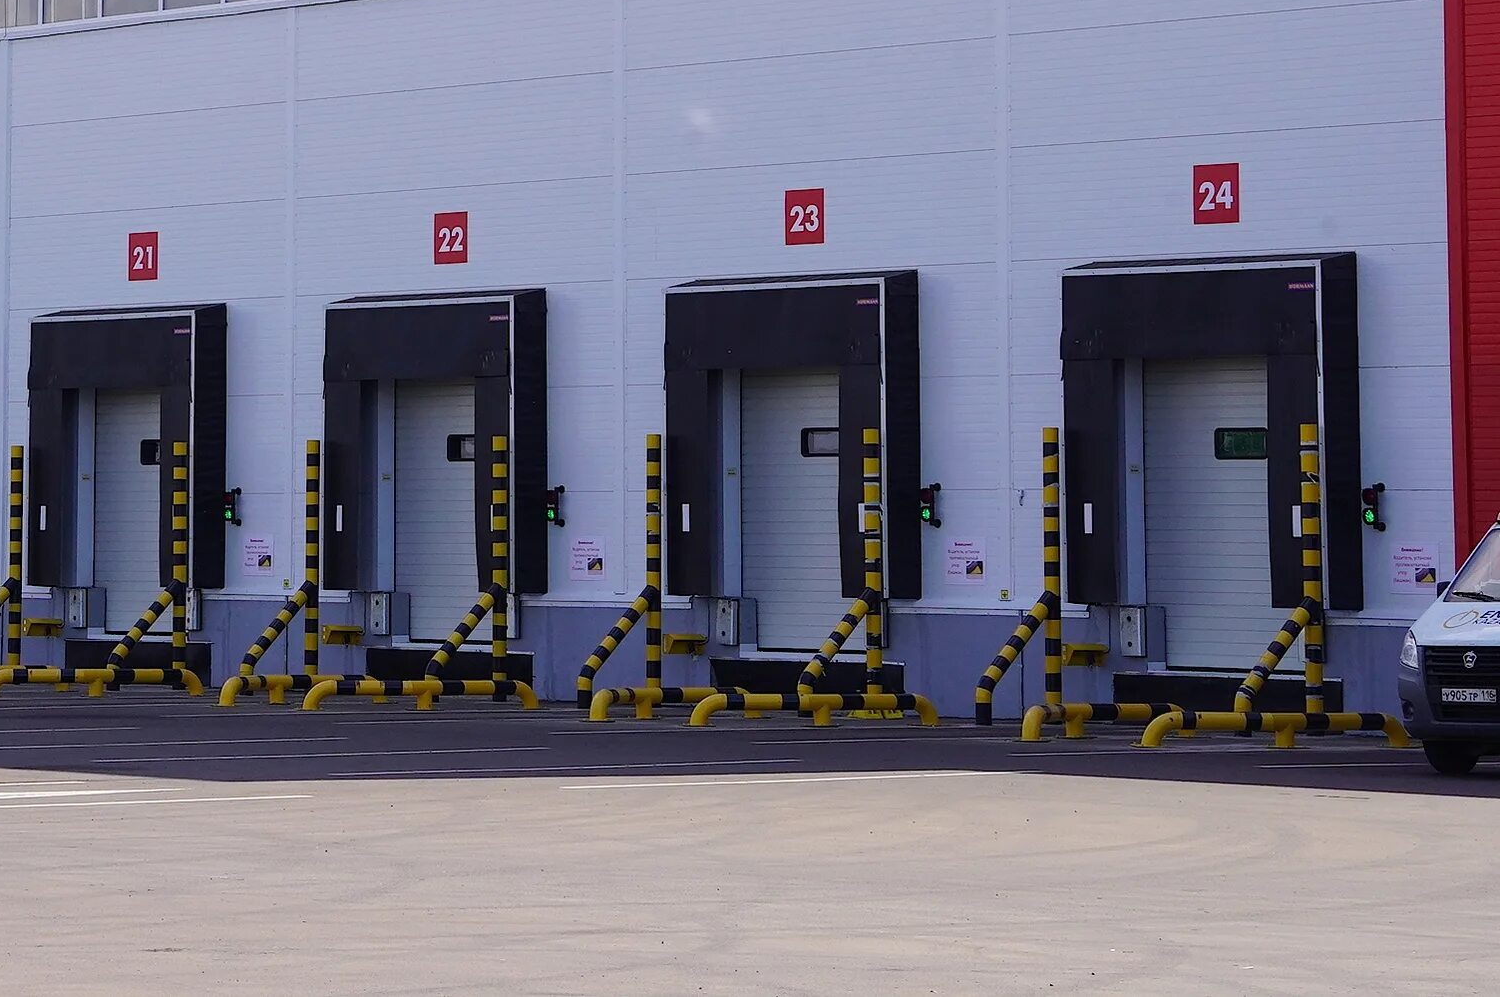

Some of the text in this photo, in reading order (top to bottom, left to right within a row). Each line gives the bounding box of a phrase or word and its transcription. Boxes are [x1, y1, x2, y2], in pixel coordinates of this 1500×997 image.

[1197, 181, 1232, 211] 24
[790, 205, 819, 232] 23
[436, 227, 461, 252] 22
[132, 246, 153, 270] 21
